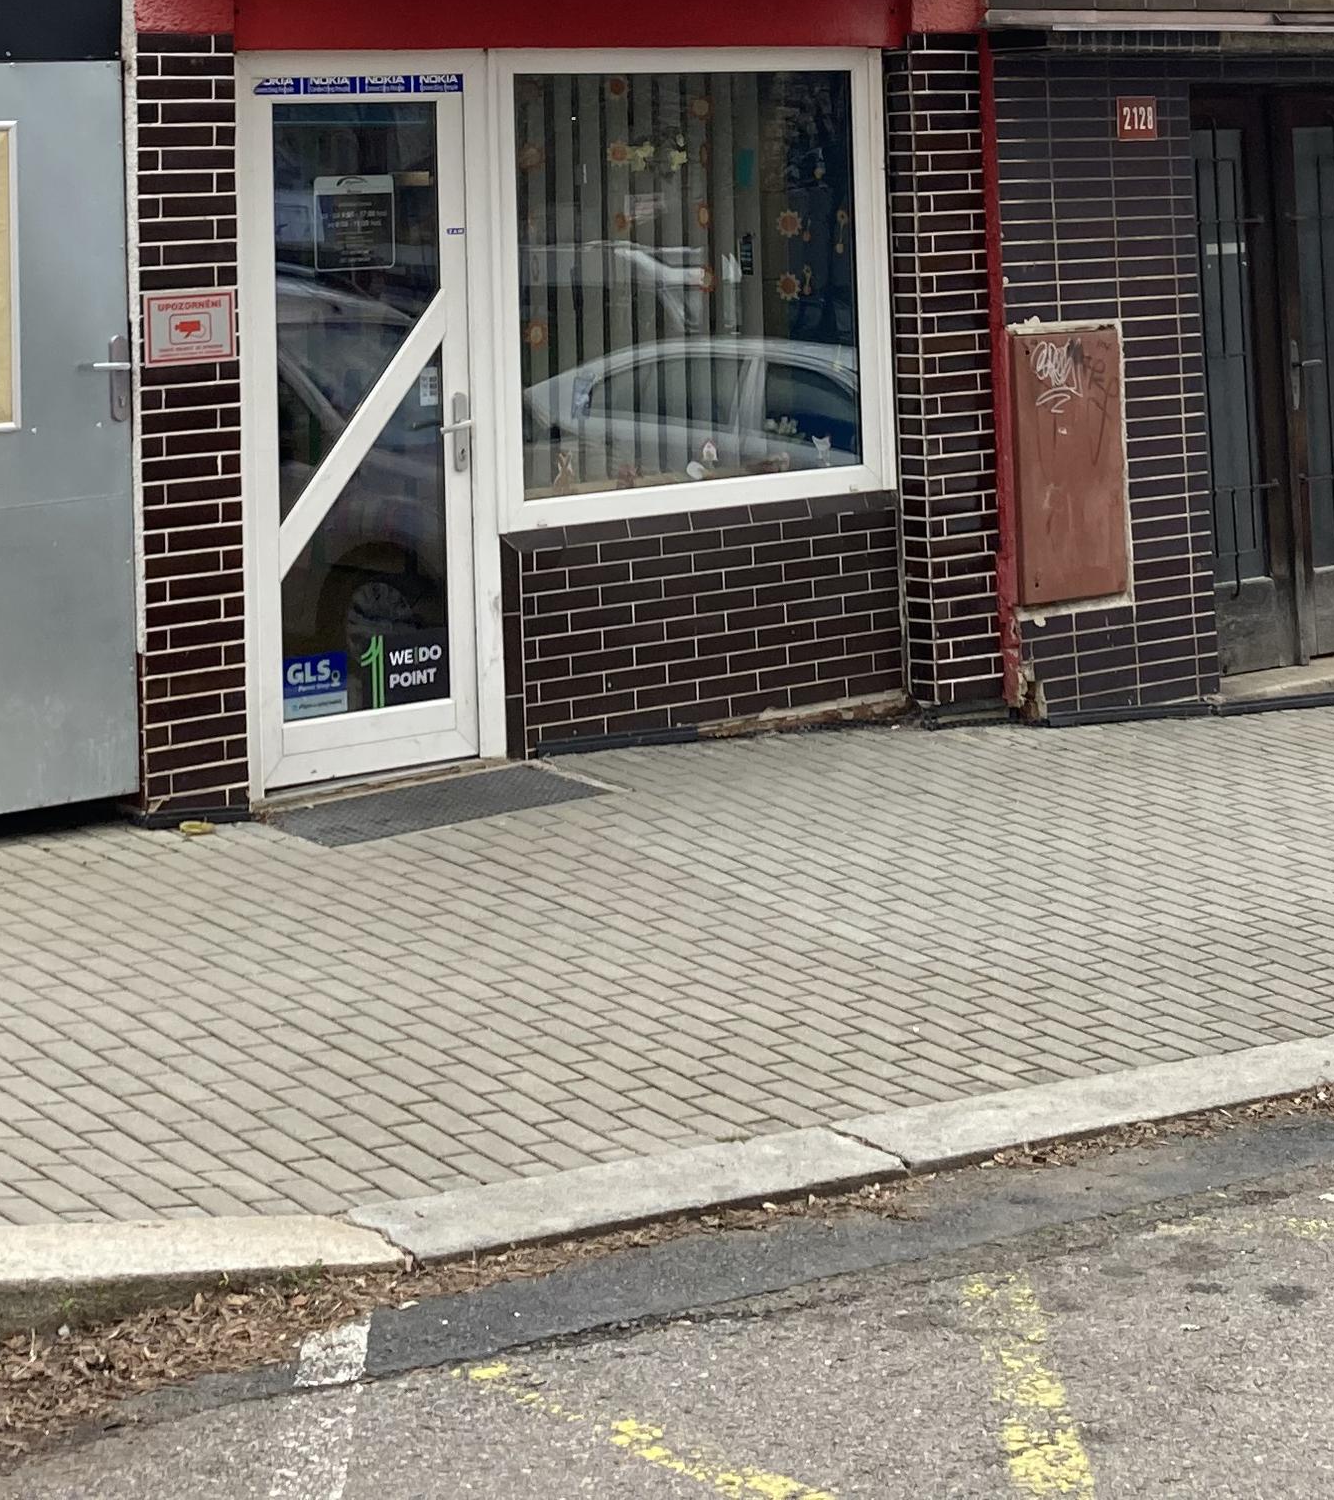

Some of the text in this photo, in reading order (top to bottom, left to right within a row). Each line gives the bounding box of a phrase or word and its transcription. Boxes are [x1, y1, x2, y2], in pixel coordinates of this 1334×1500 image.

[310, 77, 350, 86] NOKIA
[365, 75, 405, 85] NOKIA
[419, 74, 458, 84] NOKIA
[1122, 106, 1154, 130] 2128
[286, 658, 332, 686] GLS
[389, 667, 437, 689] POINT
